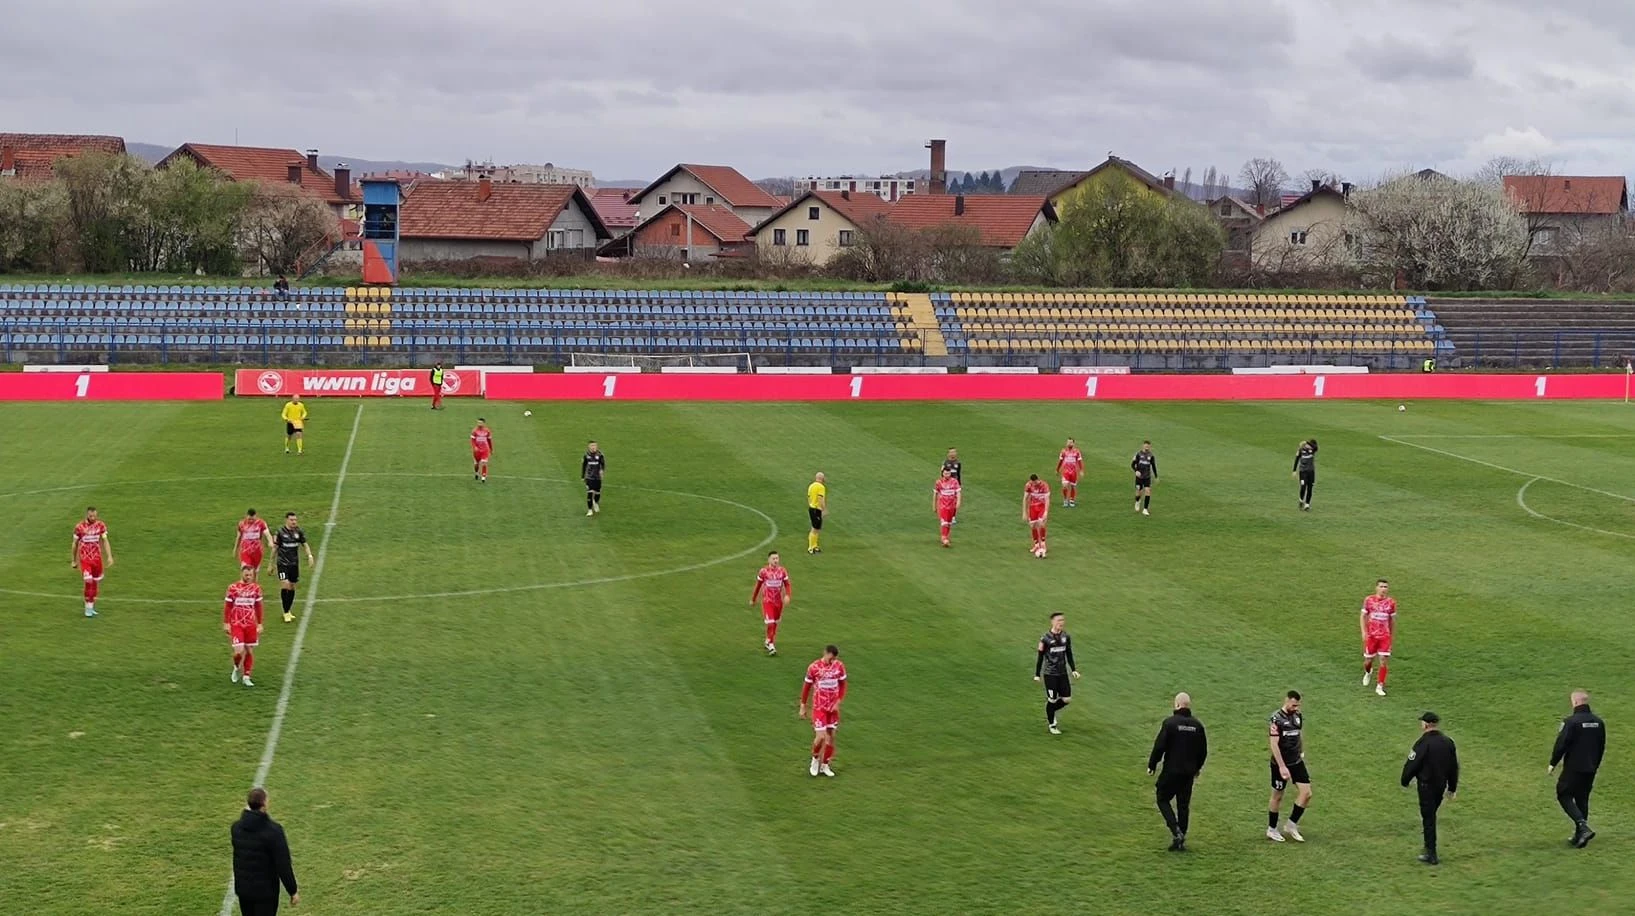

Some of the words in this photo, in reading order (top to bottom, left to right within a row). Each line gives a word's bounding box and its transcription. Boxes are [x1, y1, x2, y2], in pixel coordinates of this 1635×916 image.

[75, 375, 89, 397] 1
[371, 372, 416, 395] liga
[603, 376, 616, 397] 1
[850, 376, 863, 397] 1
[1085, 376, 1098, 397] 1
[1312, 376, 1325, 397] 1
[1534, 376, 1547, 397] 1
